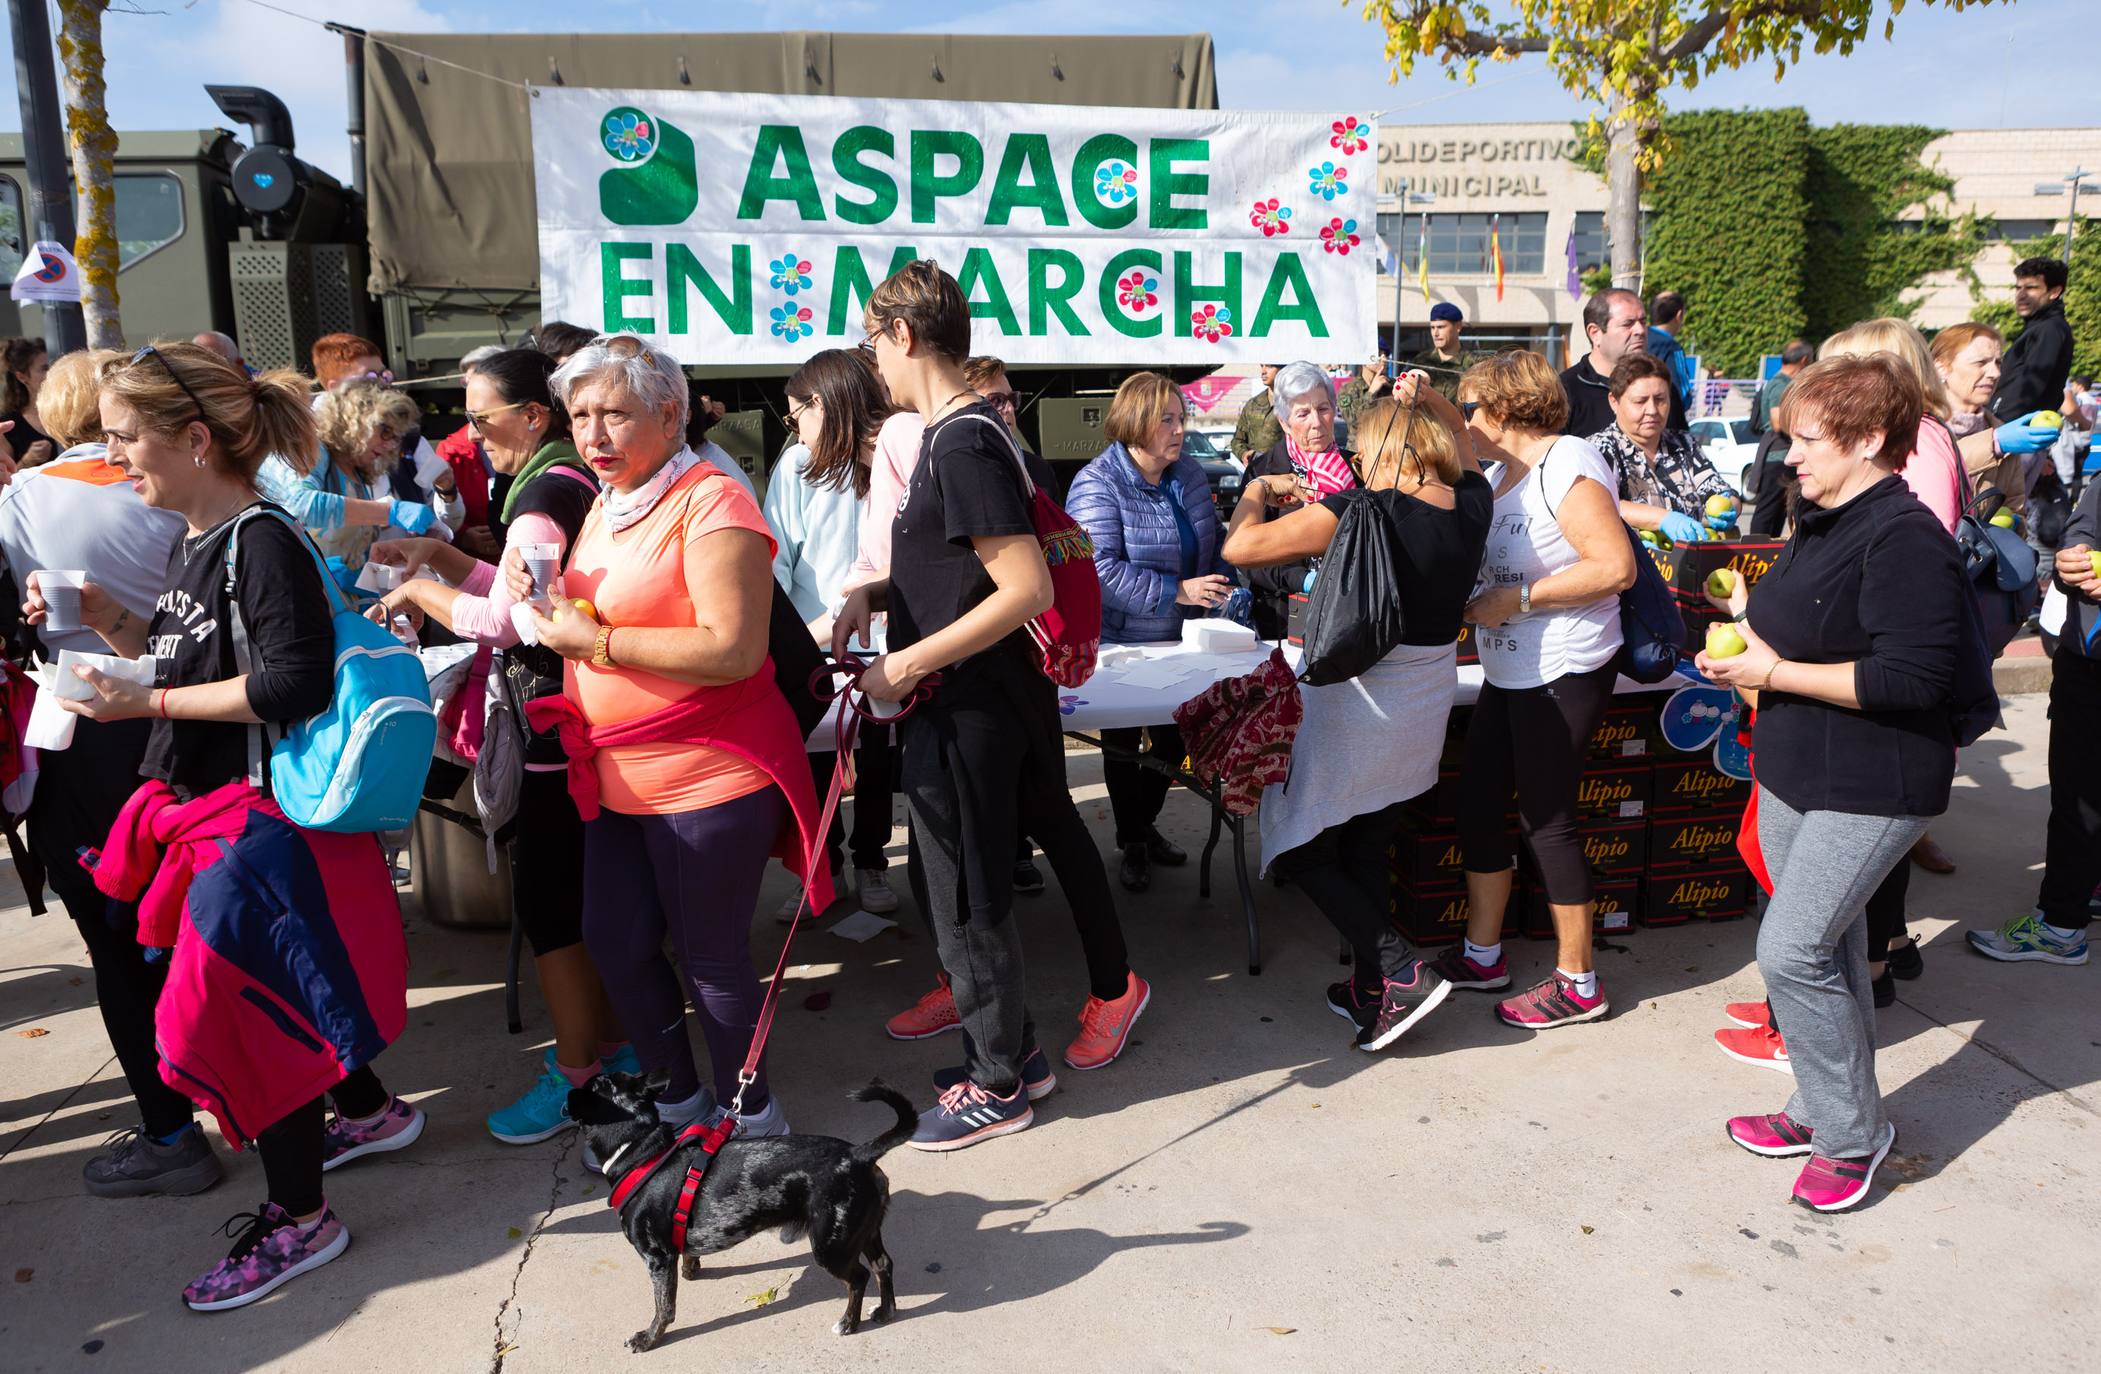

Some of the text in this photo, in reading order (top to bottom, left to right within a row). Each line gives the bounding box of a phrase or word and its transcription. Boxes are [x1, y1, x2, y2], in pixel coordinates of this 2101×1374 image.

[1378, 139, 1578, 163] OLIDEPORTIVO
[737, 125, 1209, 230] ASPACE
[1385, 175, 1546, 197] MUNICIPAL
[602, 242, 1330, 339] EN MARCHA
[1672, 769, 1736, 797] Alipio
[1670, 825, 1732, 854] Alipio
[1667, 880, 1730, 908] Alipio
